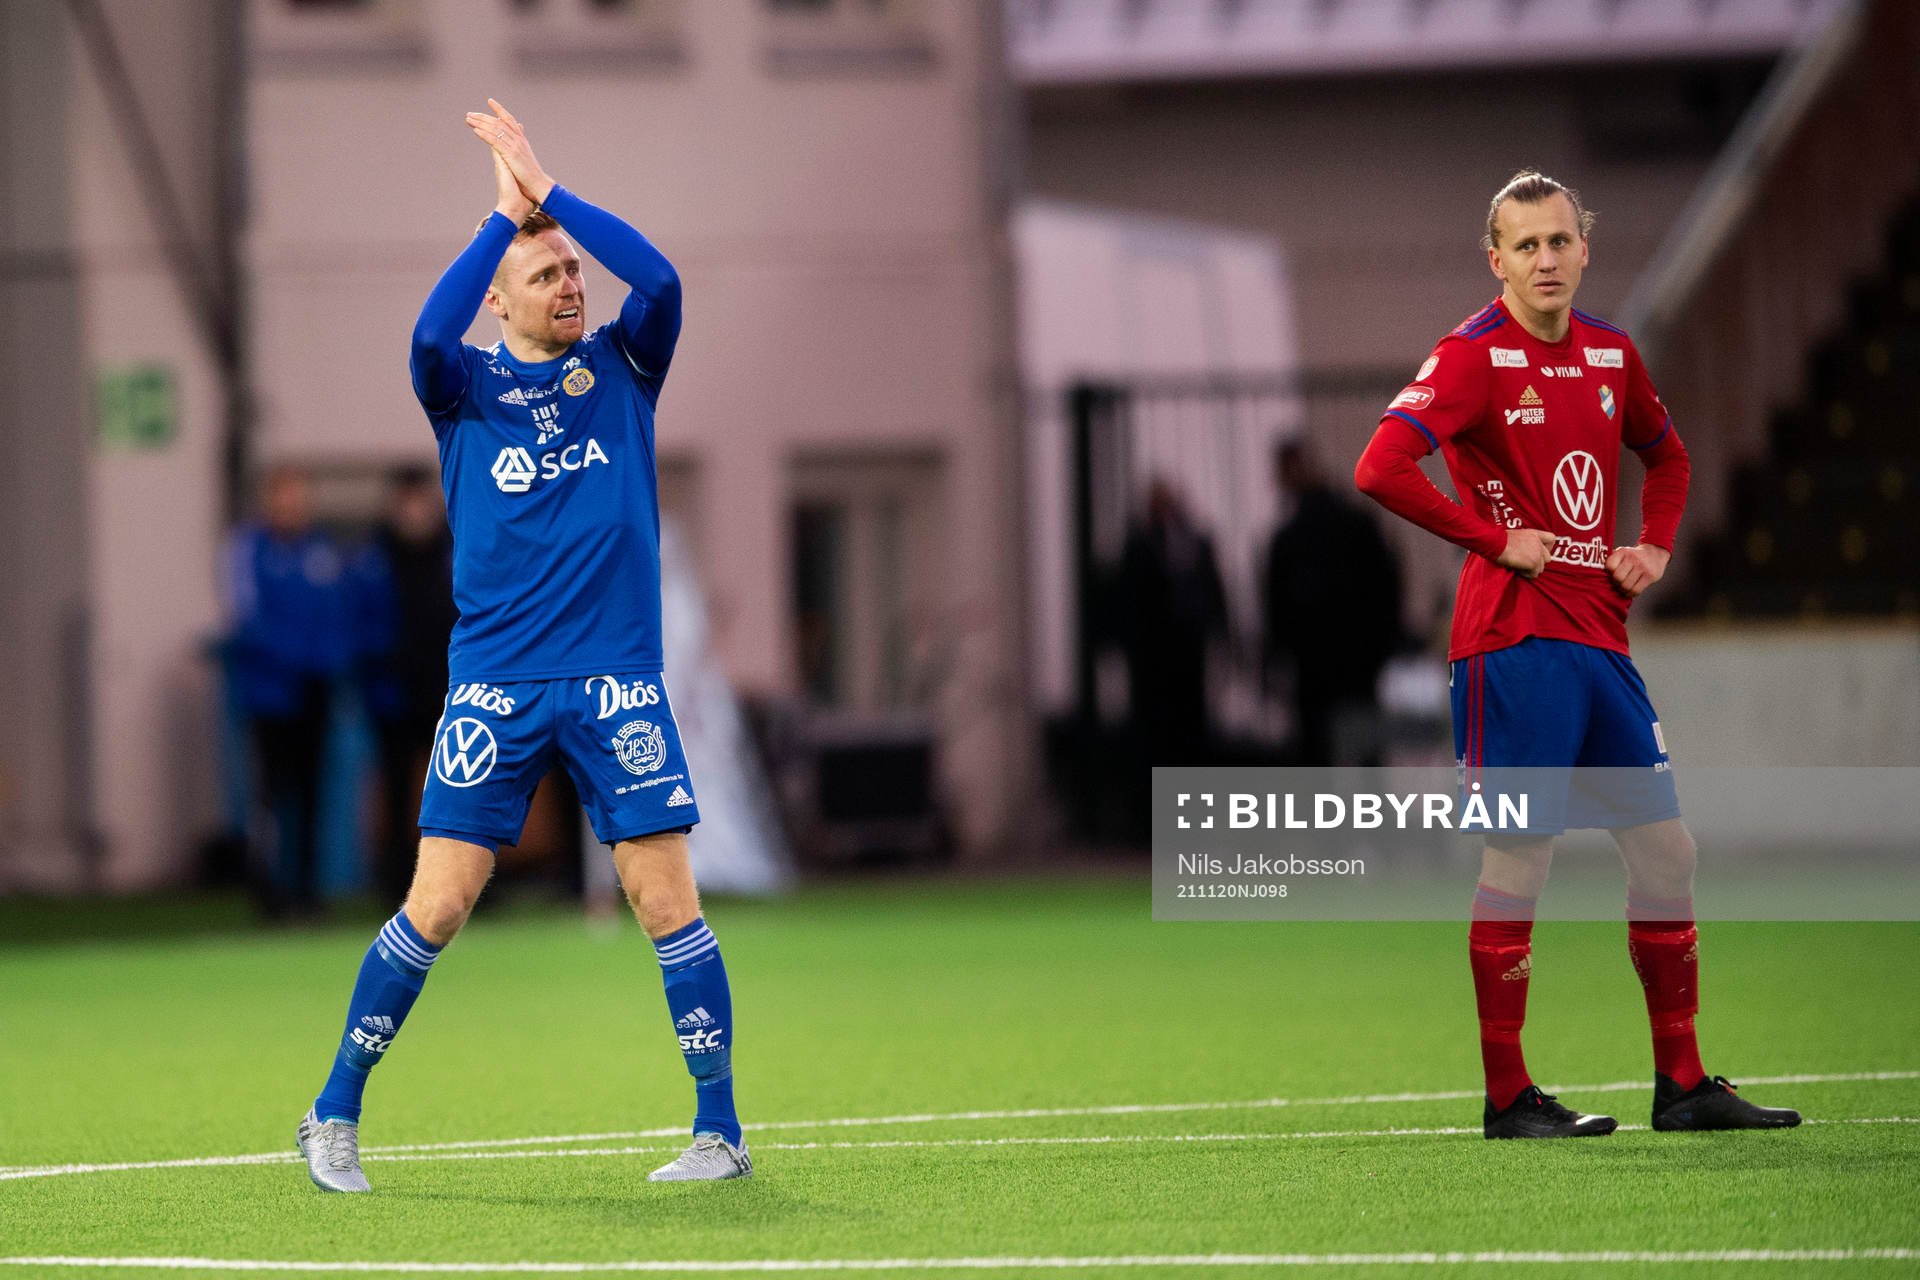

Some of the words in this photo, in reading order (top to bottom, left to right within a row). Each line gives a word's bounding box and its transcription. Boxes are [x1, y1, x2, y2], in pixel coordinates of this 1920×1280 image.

[1555, 366, 1583, 378] VISMA
[498, 395, 529, 407] adidas
[1519, 398, 1543, 406] adidas
[1521, 408, 1545, 417] INTER
[1521, 416, 1545, 425] SPORT
[541, 438, 610, 480] SCA
[585, 675, 660, 720] Diös
[626, 735, 658, 761] HSB
[667, 797, 694, 808] adidas
[361, 1016, 397, 1035] adidas
[676, 1018, 716, 1029] adidas
[350, 1027, 392, 1053] stc
[679, 1029, 723, 1050] stc
